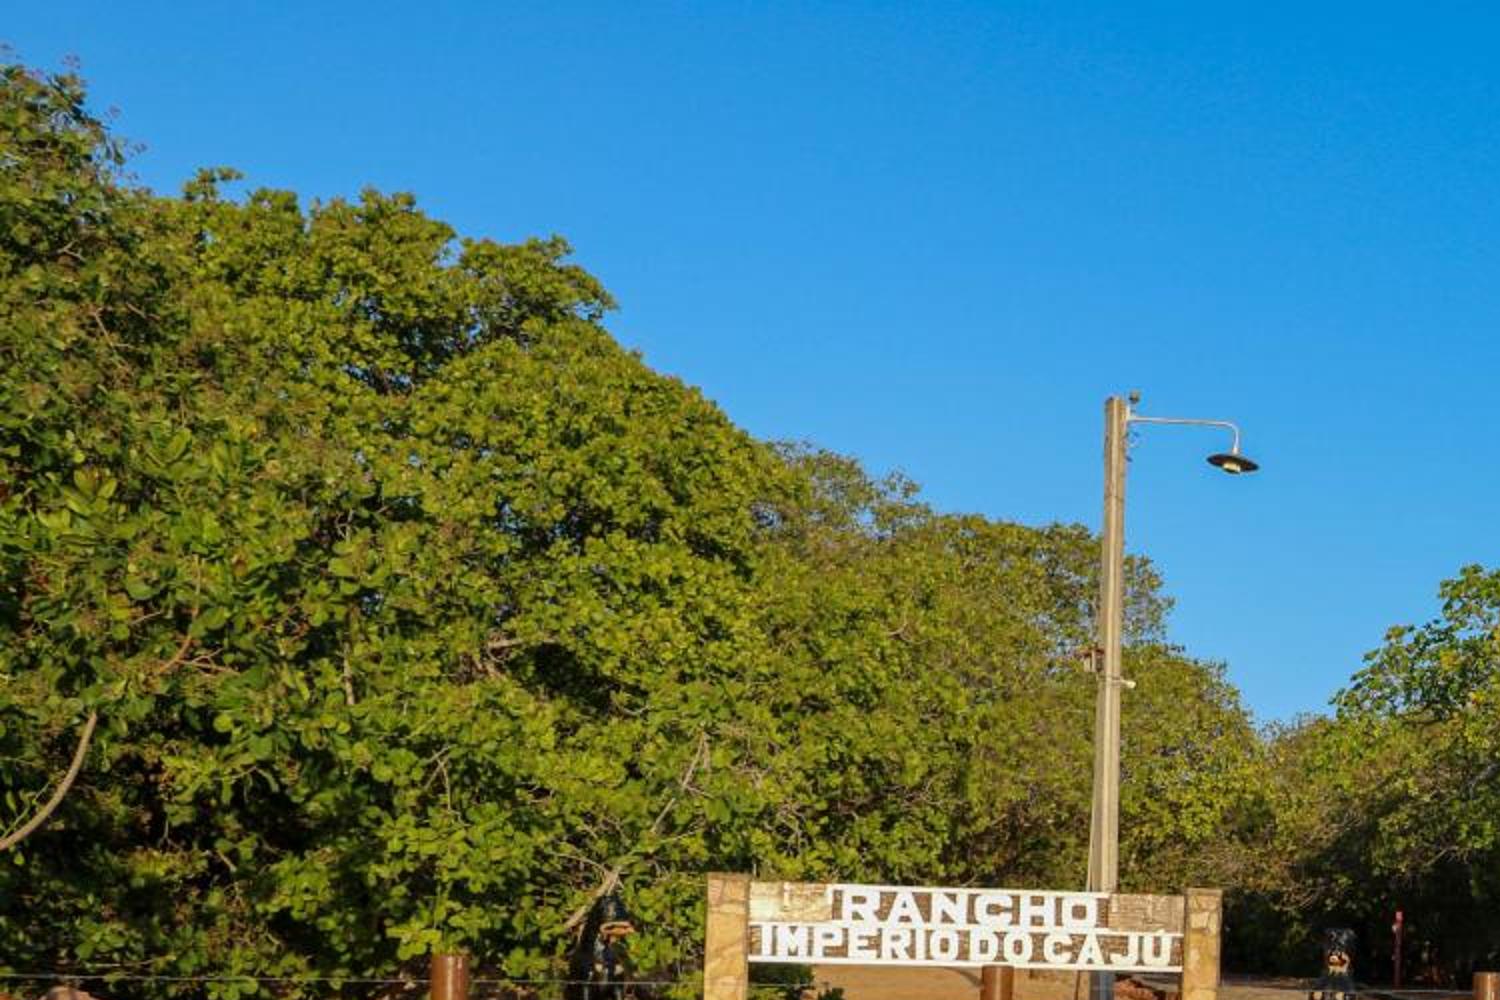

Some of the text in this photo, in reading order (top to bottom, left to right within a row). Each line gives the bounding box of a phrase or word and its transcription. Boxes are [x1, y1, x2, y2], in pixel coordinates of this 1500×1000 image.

[842, 887, 1098, 929] RANCHO
[761, 924, 959, 962] IMPERIO
[970, 929, 1033, 963] DO
